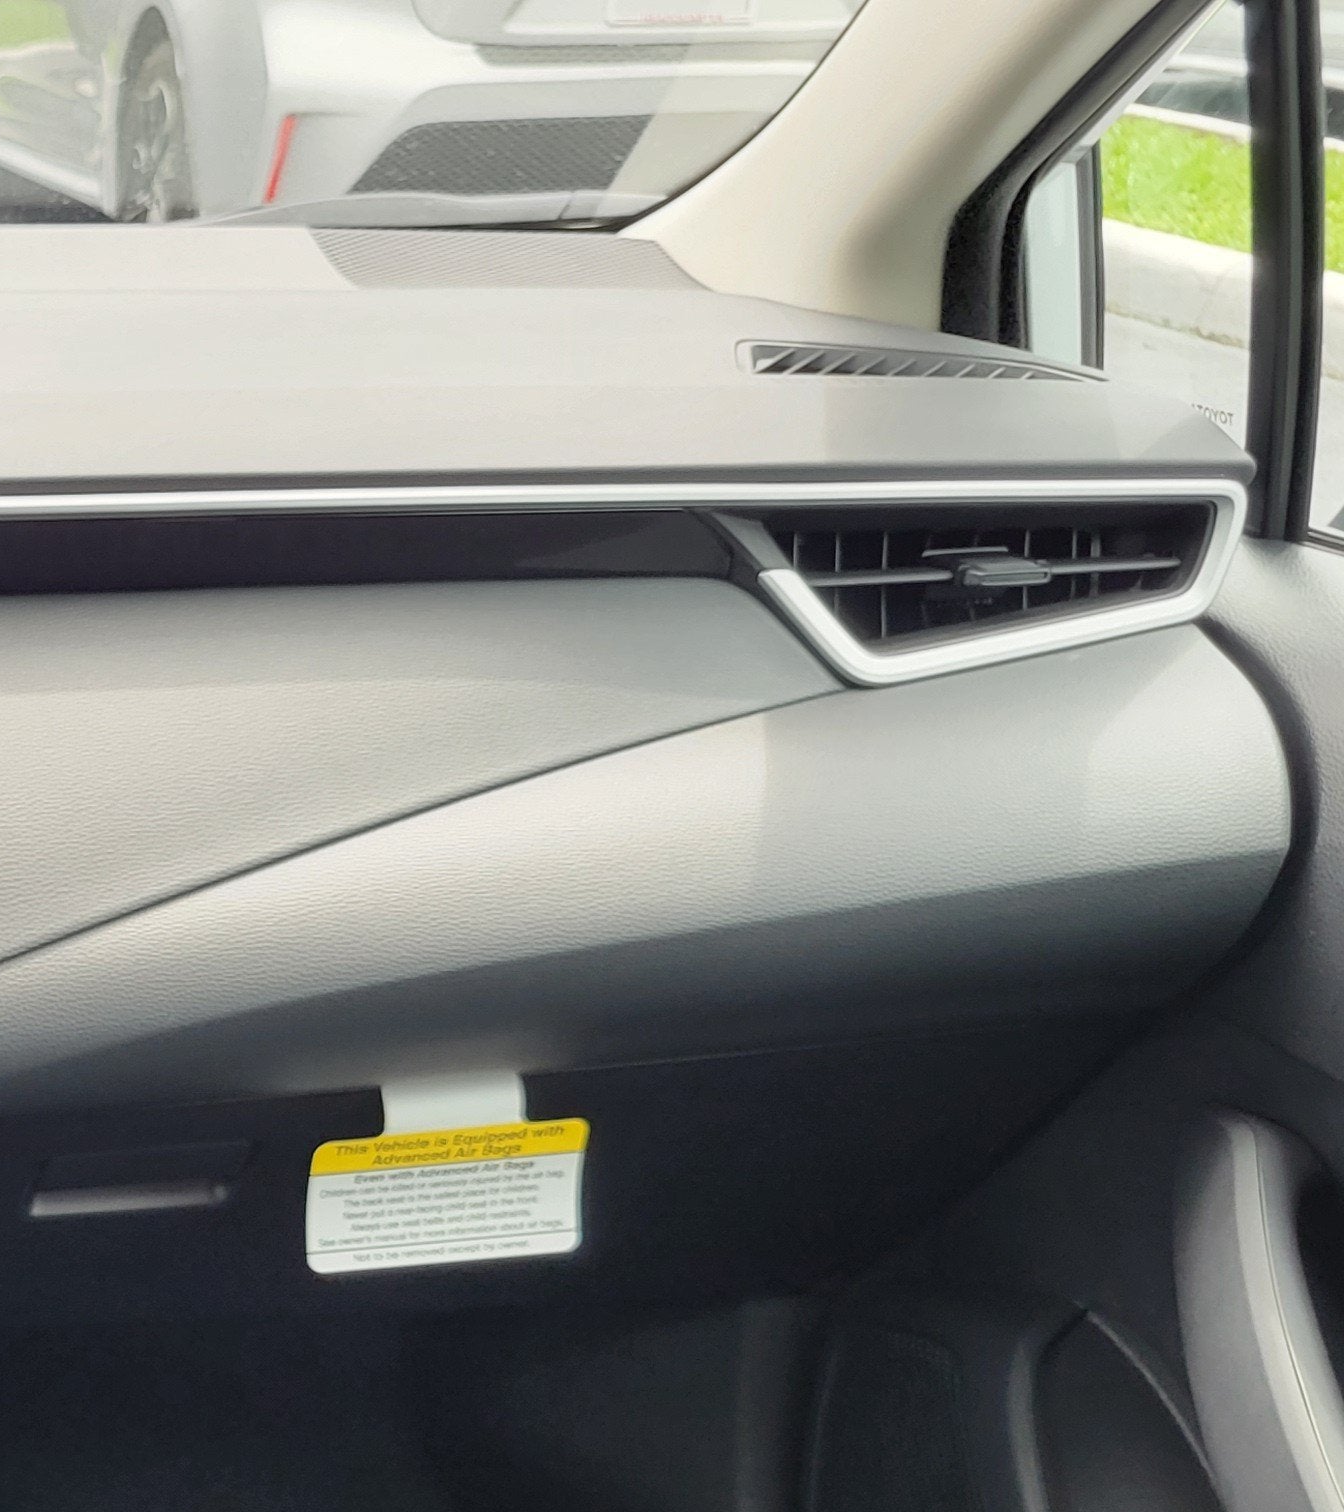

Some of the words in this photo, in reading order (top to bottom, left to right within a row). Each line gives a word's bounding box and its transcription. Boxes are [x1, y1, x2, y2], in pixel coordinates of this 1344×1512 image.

[335, 1144, 369, 1157] This
[373, 1138, 427, 1153] Vehicle
[434, 1136, 447, 1148] is
[452, 1129, 529, 1148] Equipped
[533, 1126, 565, 1139] with
[372, 1149, 451, 1166] Advanced
[454, 1147, 476, 1158] Air
[481, 1143, 522, 1158] Bags
